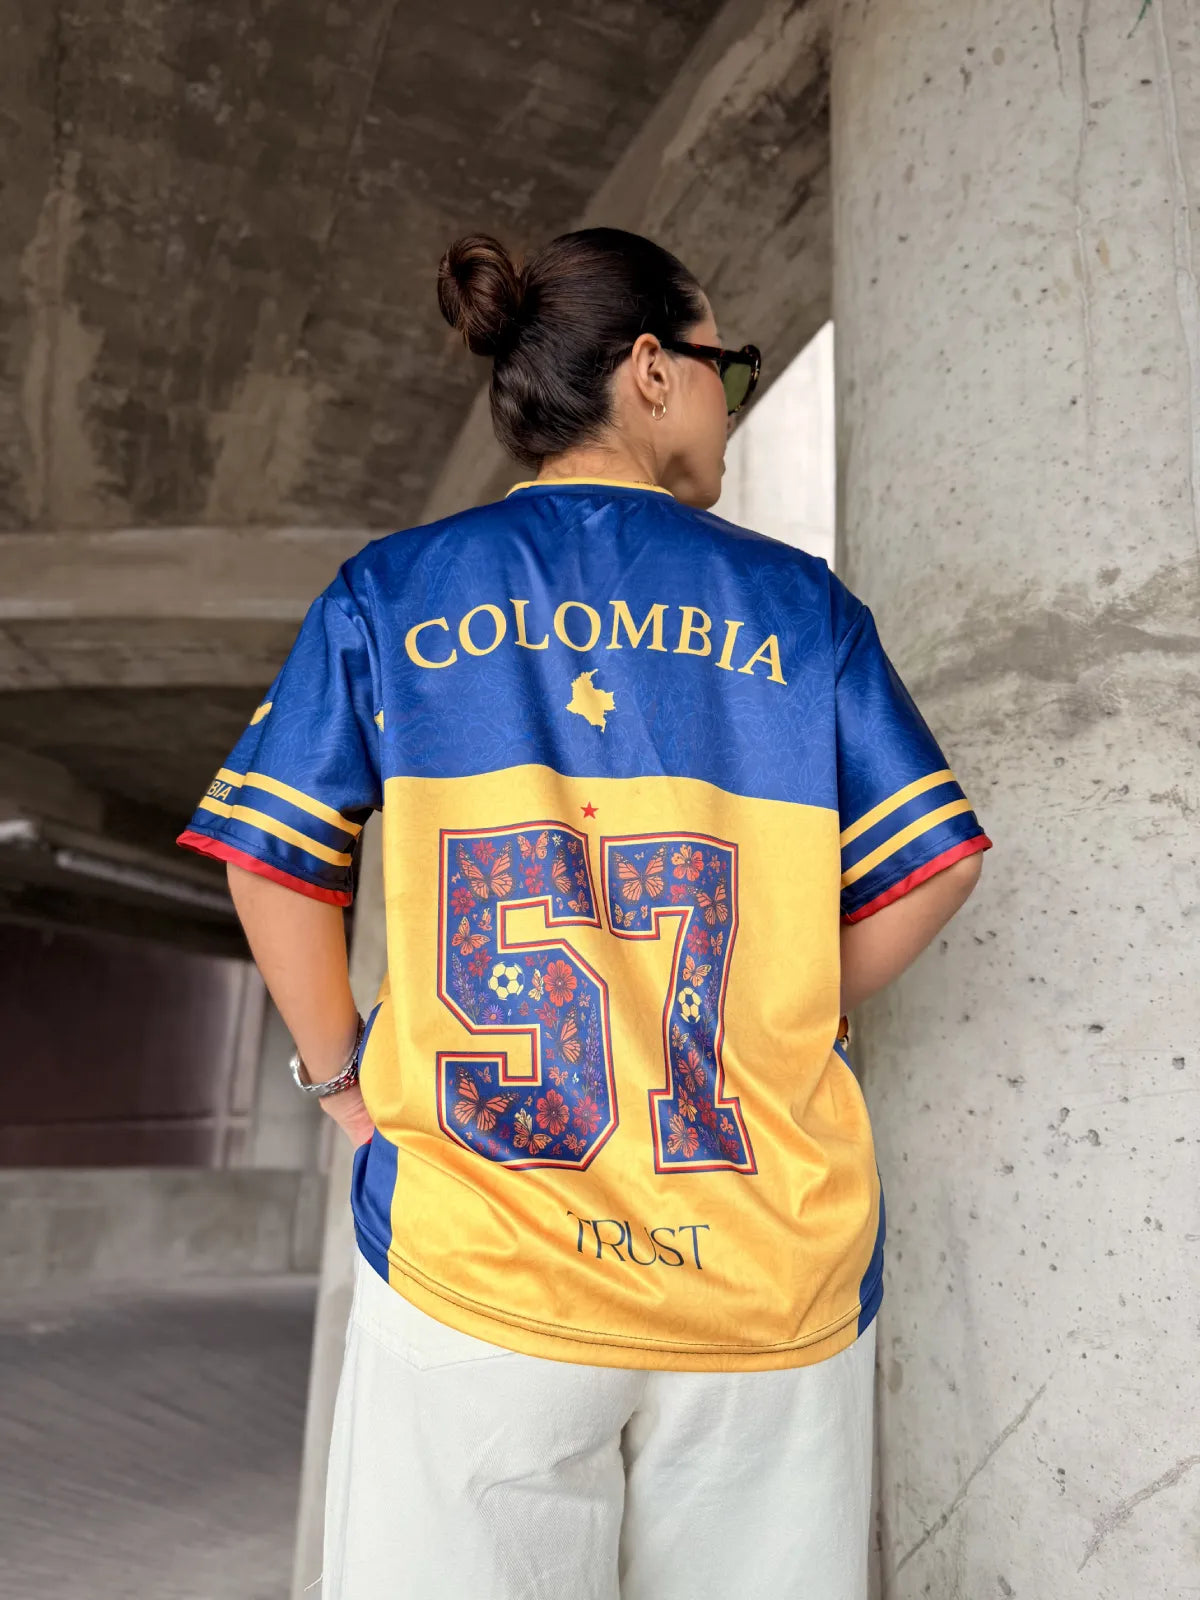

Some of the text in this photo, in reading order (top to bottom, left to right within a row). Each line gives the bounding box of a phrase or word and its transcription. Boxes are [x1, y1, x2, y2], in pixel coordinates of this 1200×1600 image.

[405, 599, 787, 685] COLOMBIA
[436, 820, 758, 1174] 57
[567, 1210, 710, 1270] TRUST
